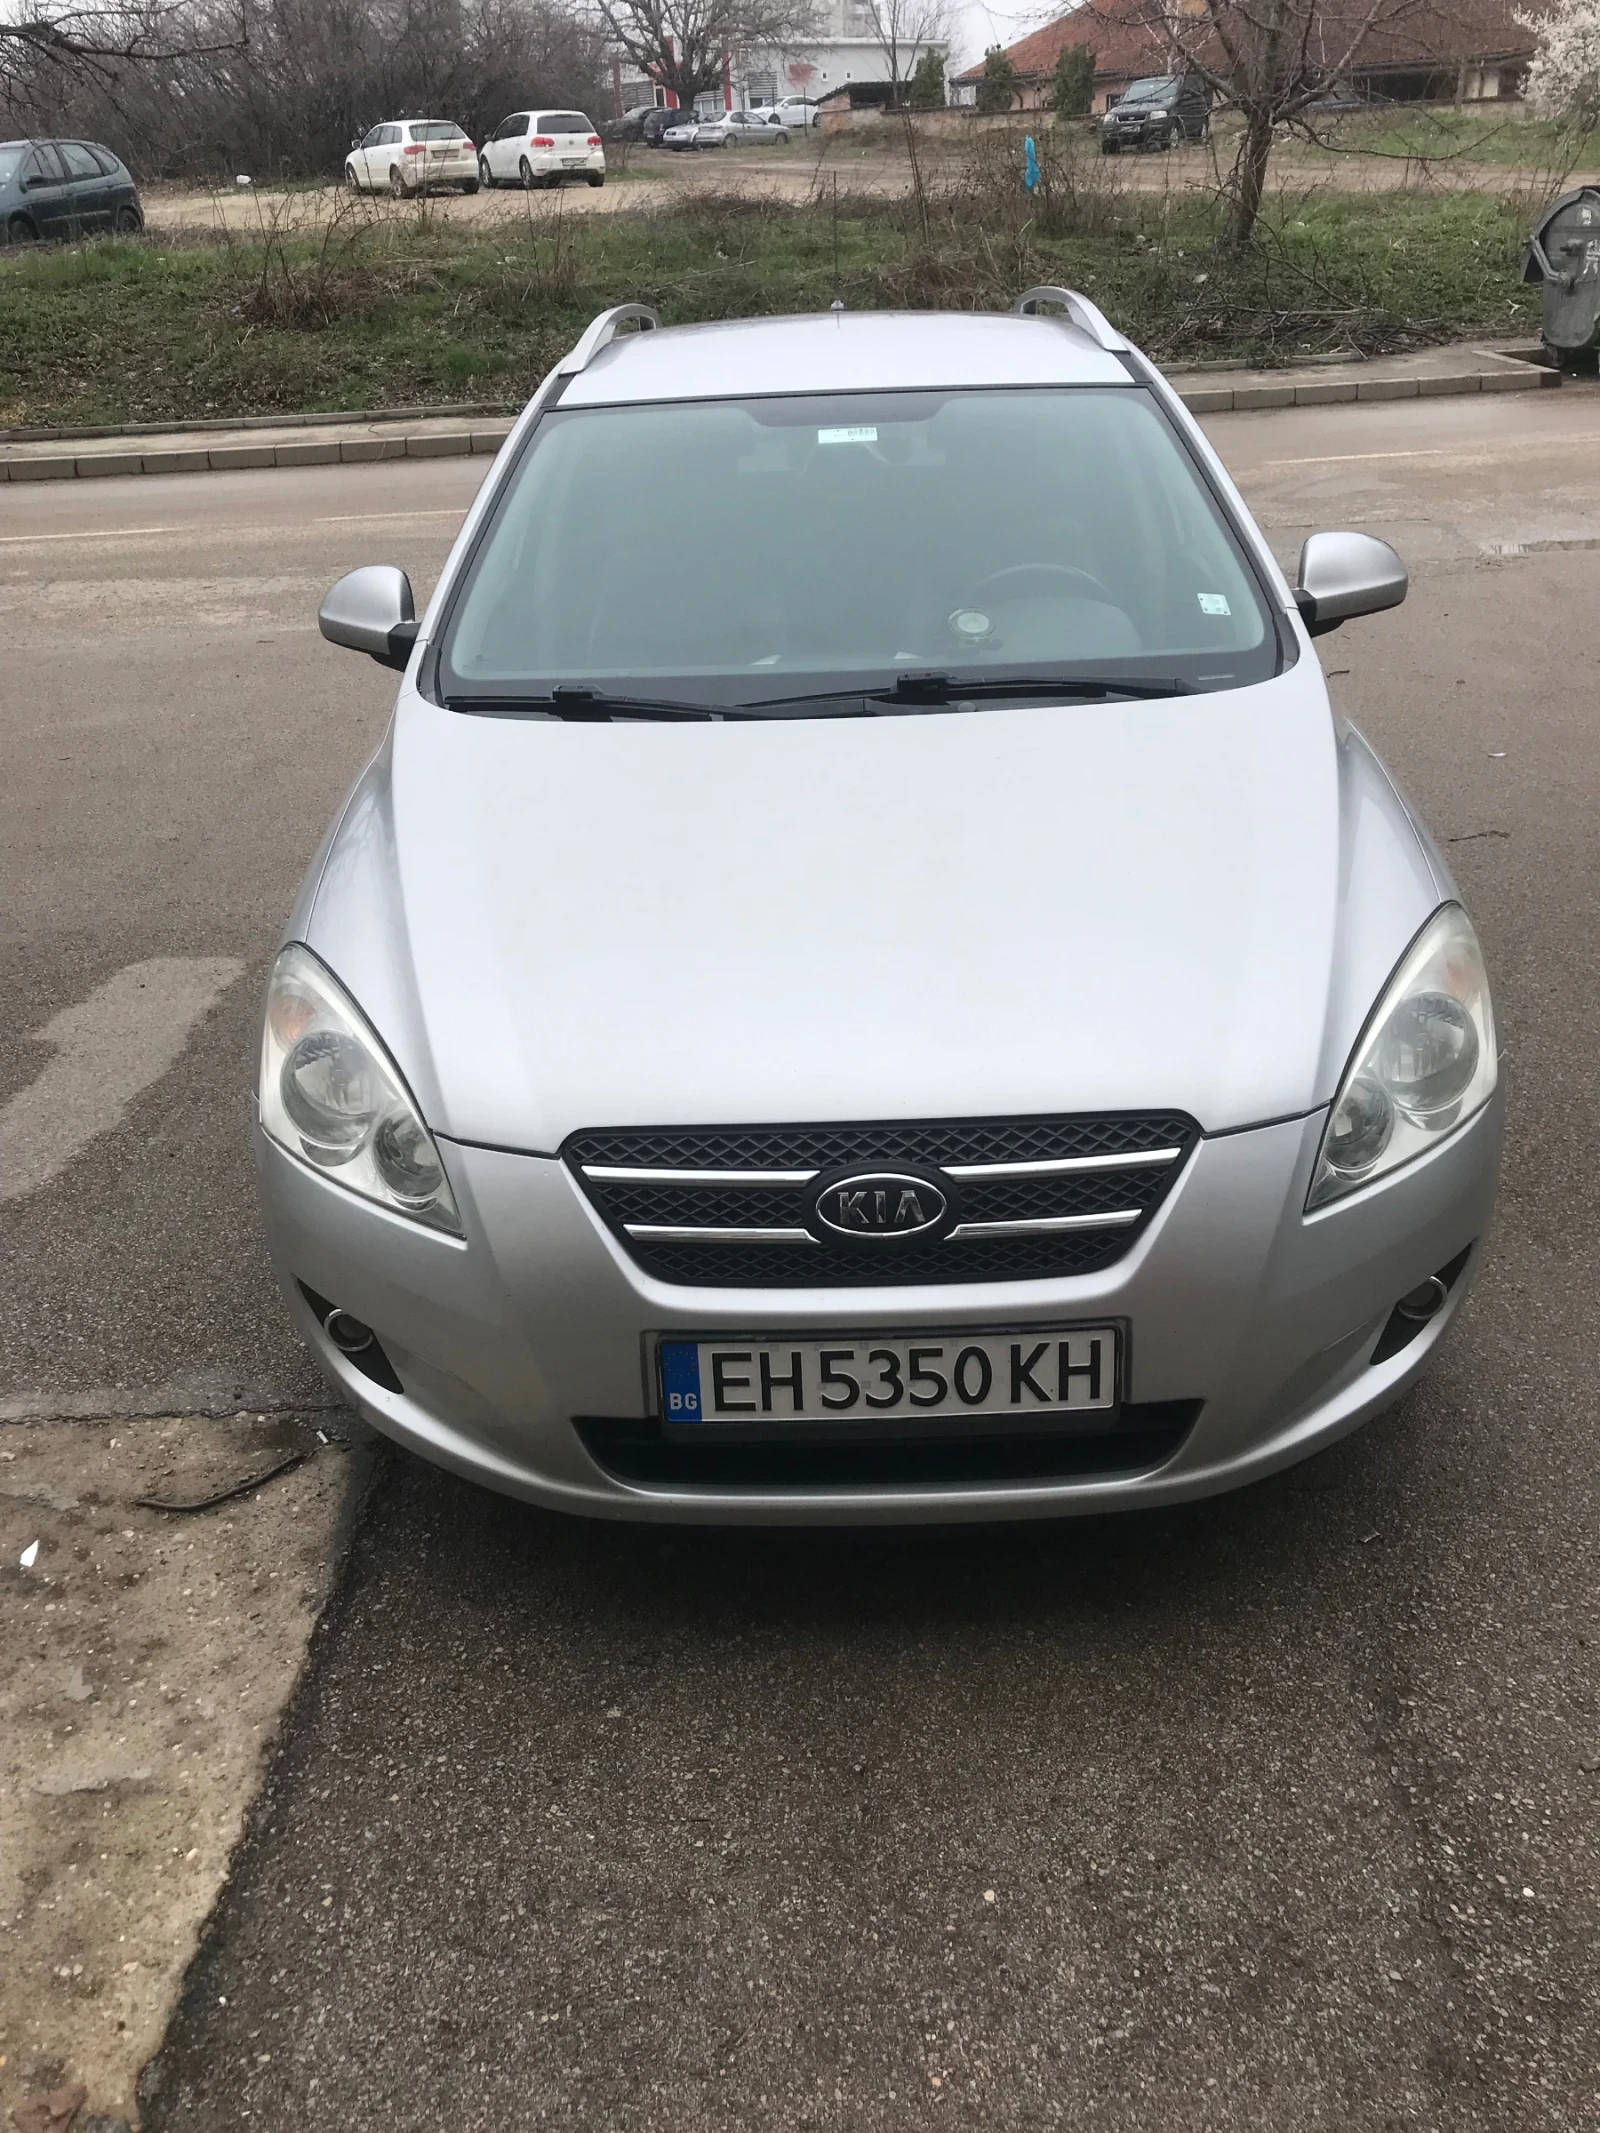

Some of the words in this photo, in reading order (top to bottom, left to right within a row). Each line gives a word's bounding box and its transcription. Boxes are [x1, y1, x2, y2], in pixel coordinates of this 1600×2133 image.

[837, 1189, 926, 1224] KIA
[711, 1351, 805, 1412] EH
[819, 1345, 993, 1410] 5350
[1010, 1338, 1102, 1404] KH
[669, 1392, 698, 1410] BG
